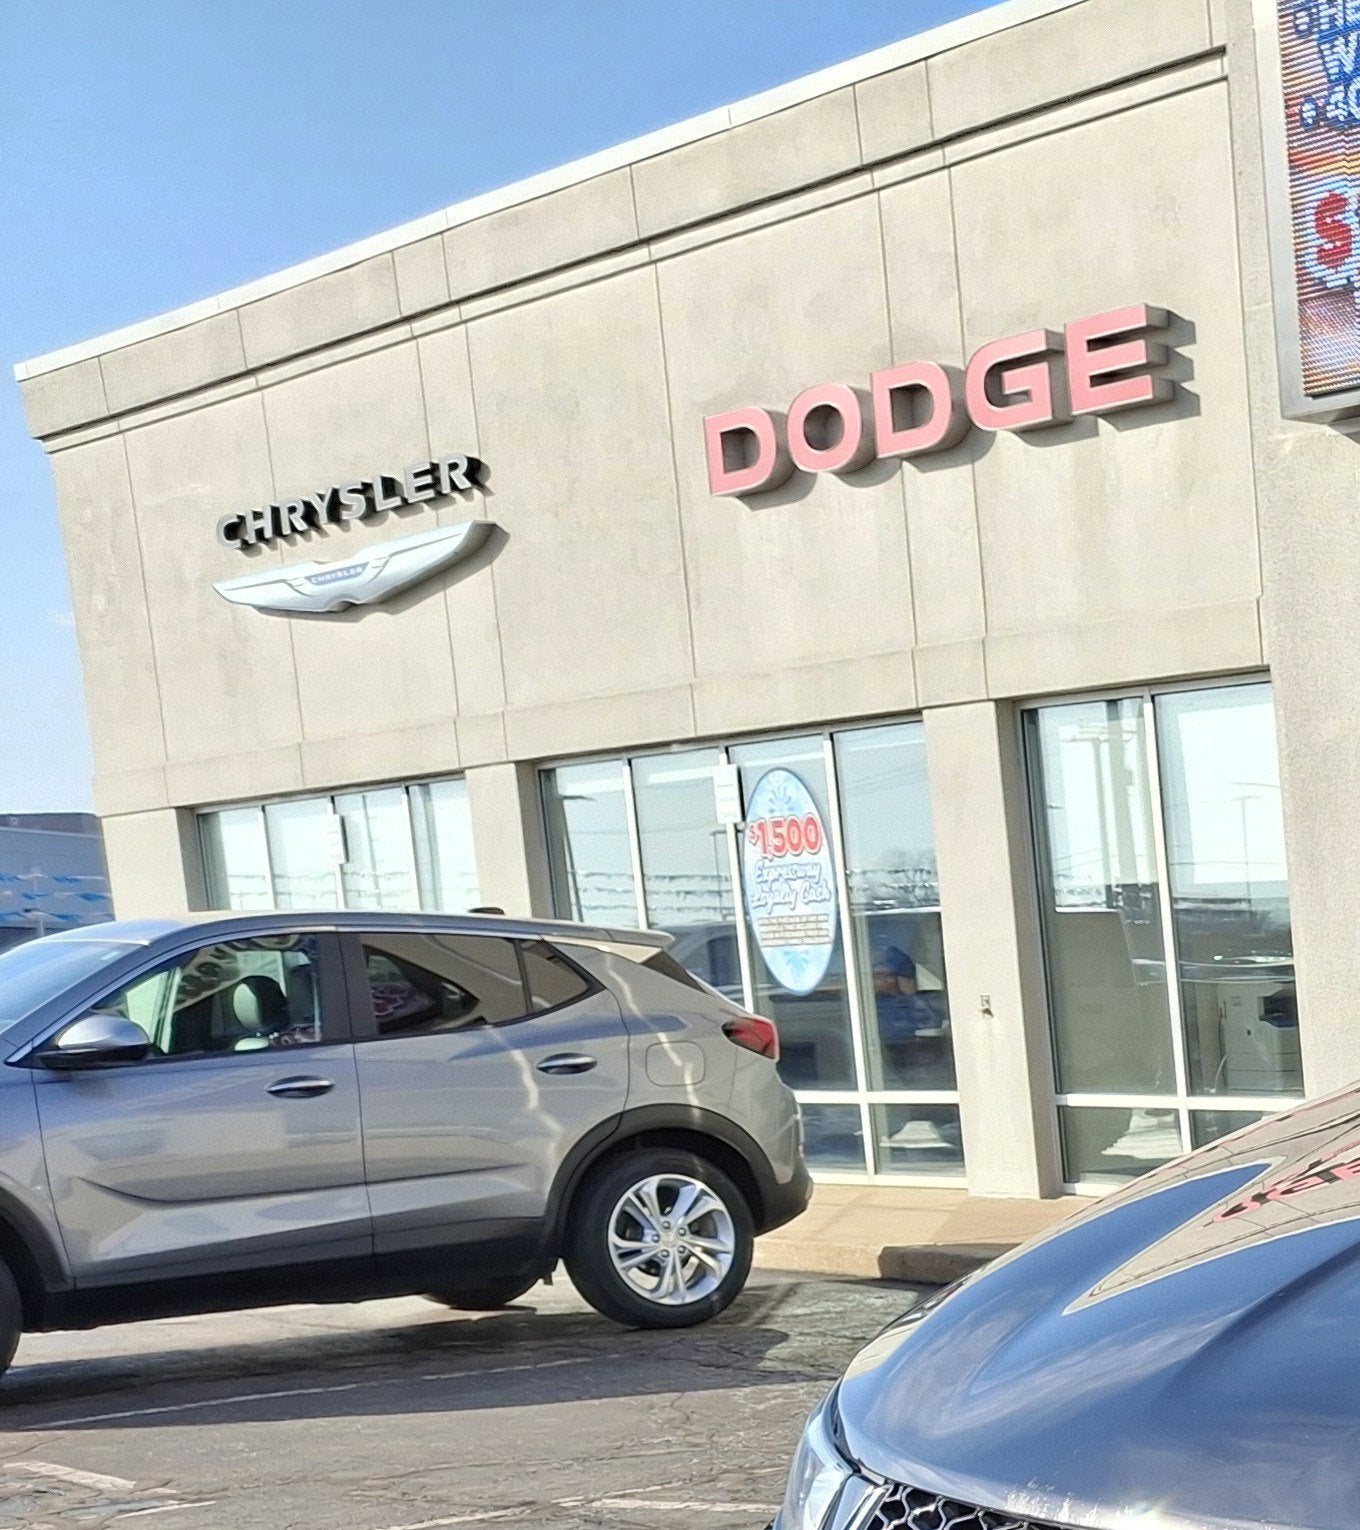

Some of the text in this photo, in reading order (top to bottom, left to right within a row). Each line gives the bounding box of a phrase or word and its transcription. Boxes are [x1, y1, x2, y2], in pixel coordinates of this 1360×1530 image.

[703, 303, 1165, 498] DODGE
[214, 452, 478, 551] CHRYSLER
[755, 860, 822, 885] Expressway
[801, 879, 832, 904] Cash
